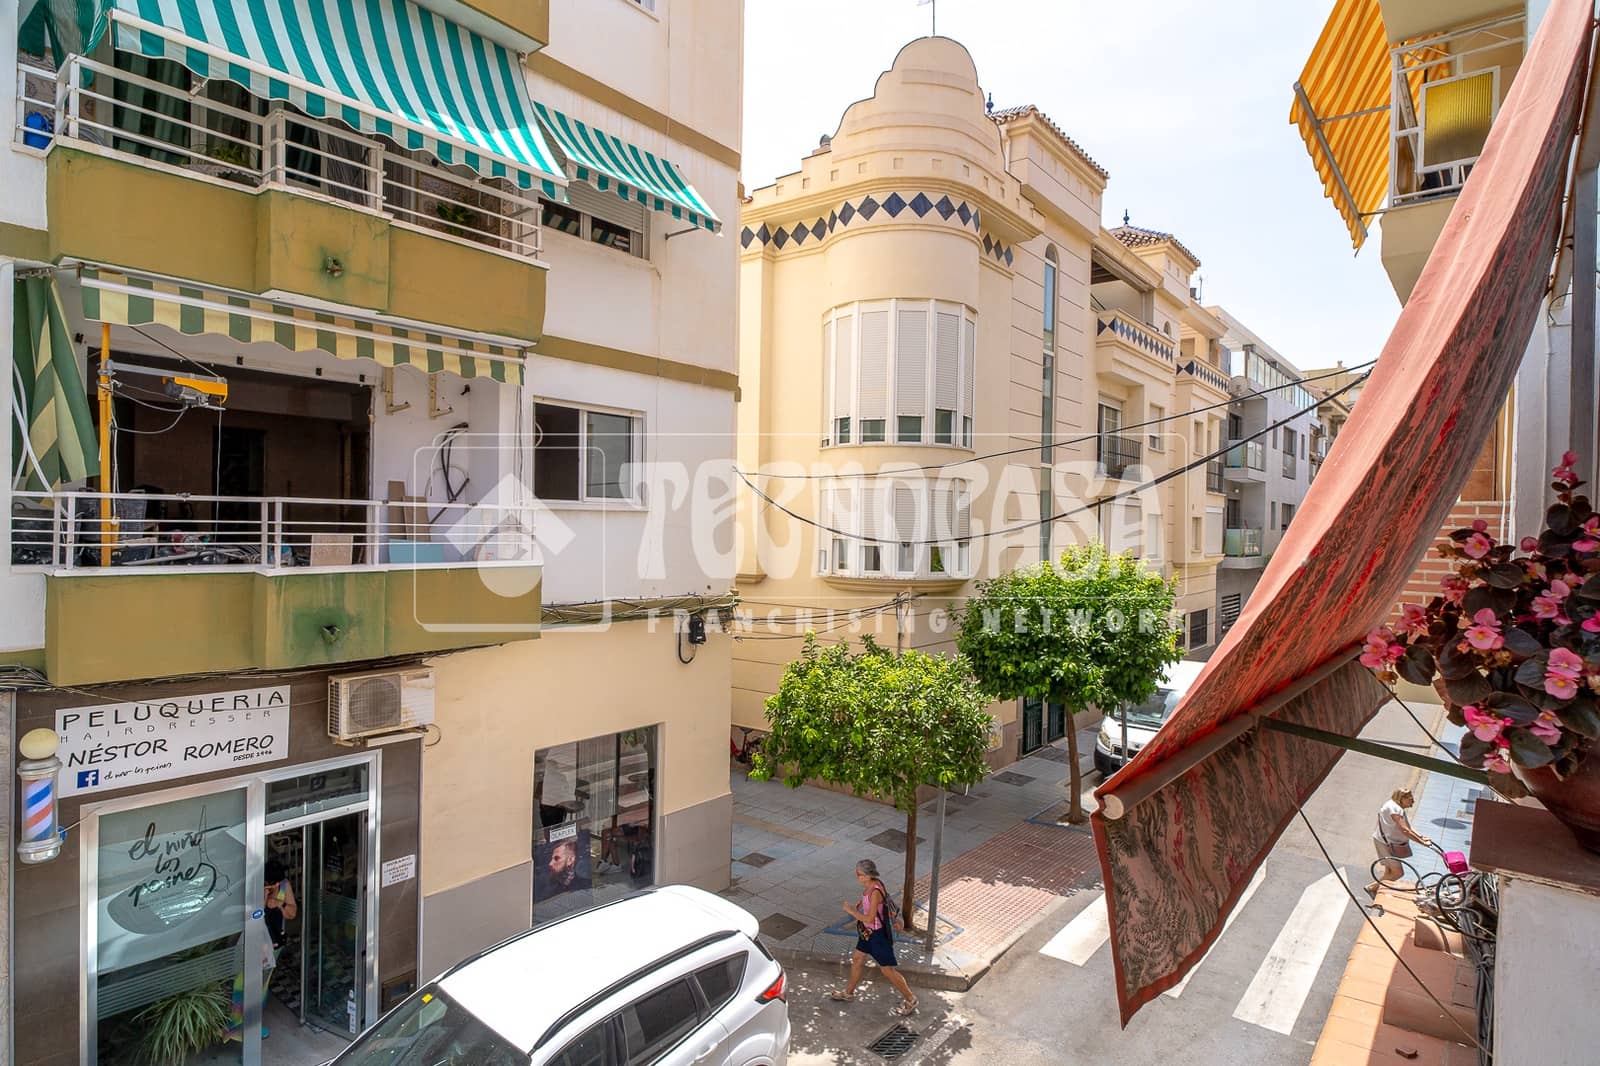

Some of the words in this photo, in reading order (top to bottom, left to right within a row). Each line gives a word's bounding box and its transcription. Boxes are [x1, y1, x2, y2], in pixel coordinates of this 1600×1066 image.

[60, 710, 271, 744] HAIRDRESSER
[62, 691, 284, 731] PELUQUERIA
[68, 738, 168, 767] NÉSTOR
[183, 734, 274, 761] ROMERO
[232, 752, 255, 761] DESDE
[128, 822, 161, 861] el
